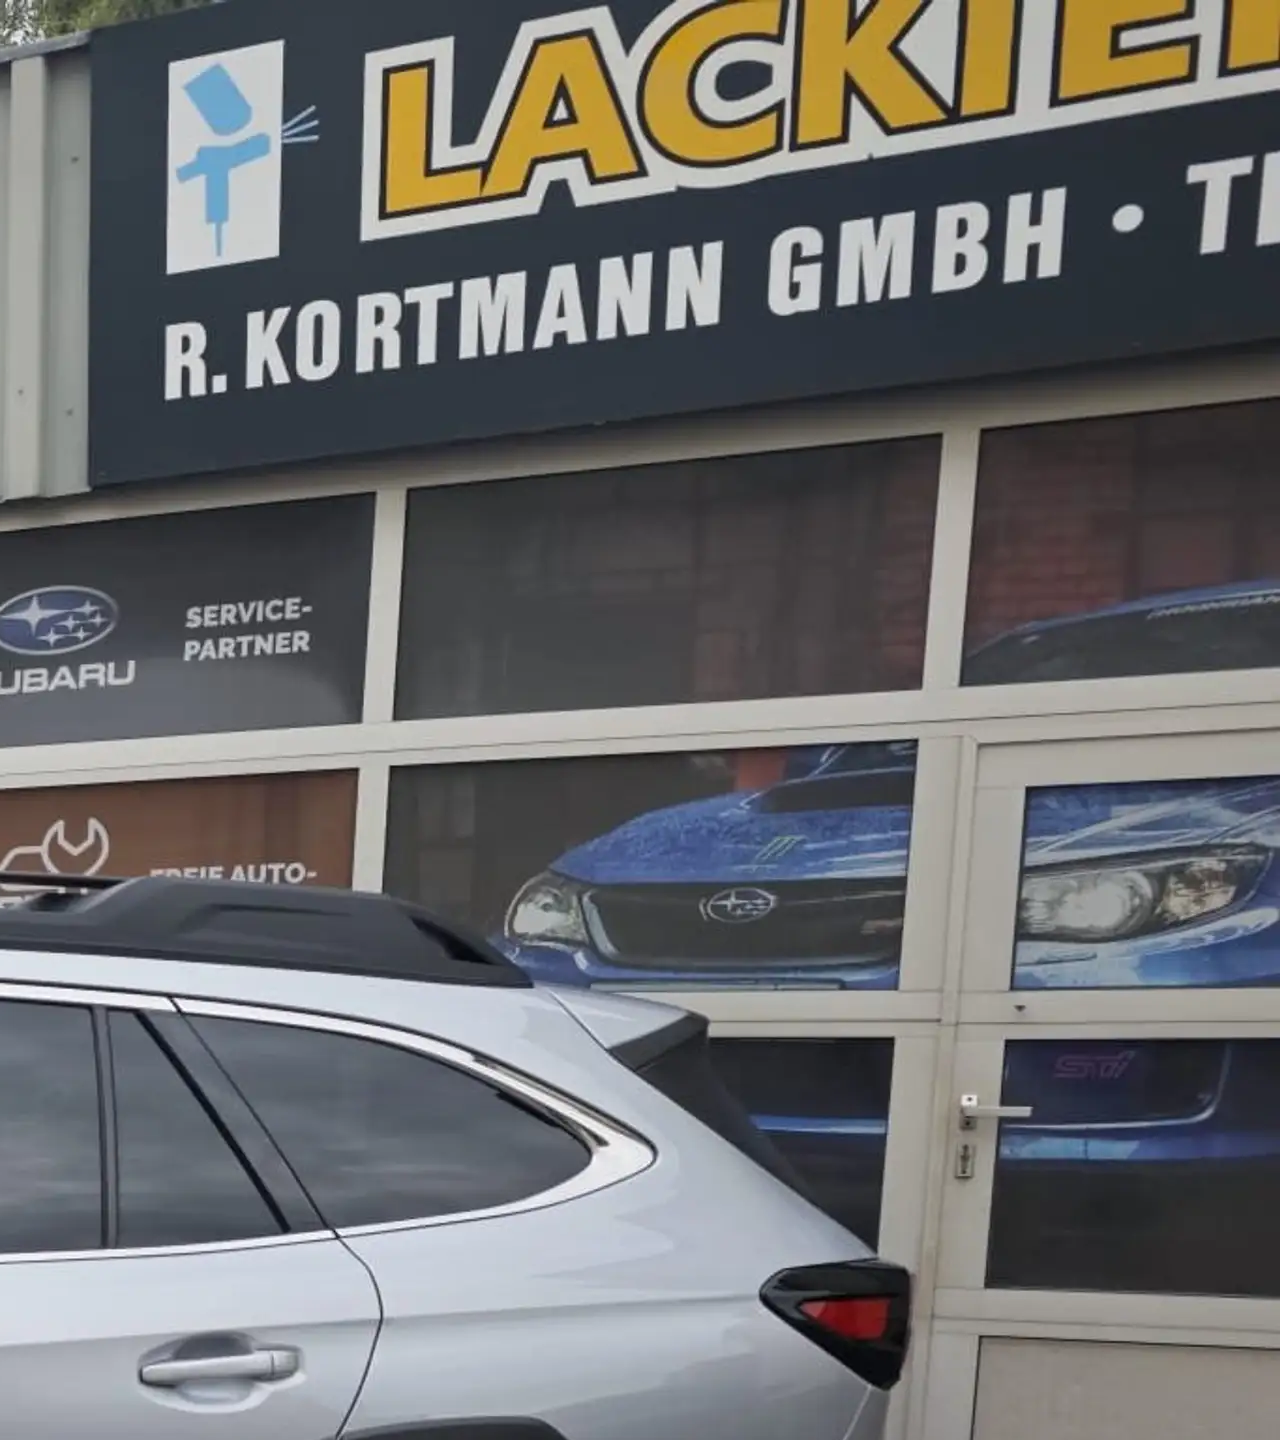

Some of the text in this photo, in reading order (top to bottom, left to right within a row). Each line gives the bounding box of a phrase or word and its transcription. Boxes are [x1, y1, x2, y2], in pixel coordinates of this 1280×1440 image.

[361, 0, 1280, 241] LACKIE
[766, 187, 1067, 316] GMBH
[183, 631, 310, 661] PARTNER
[185, 597, 312, 628] SERVICE-
